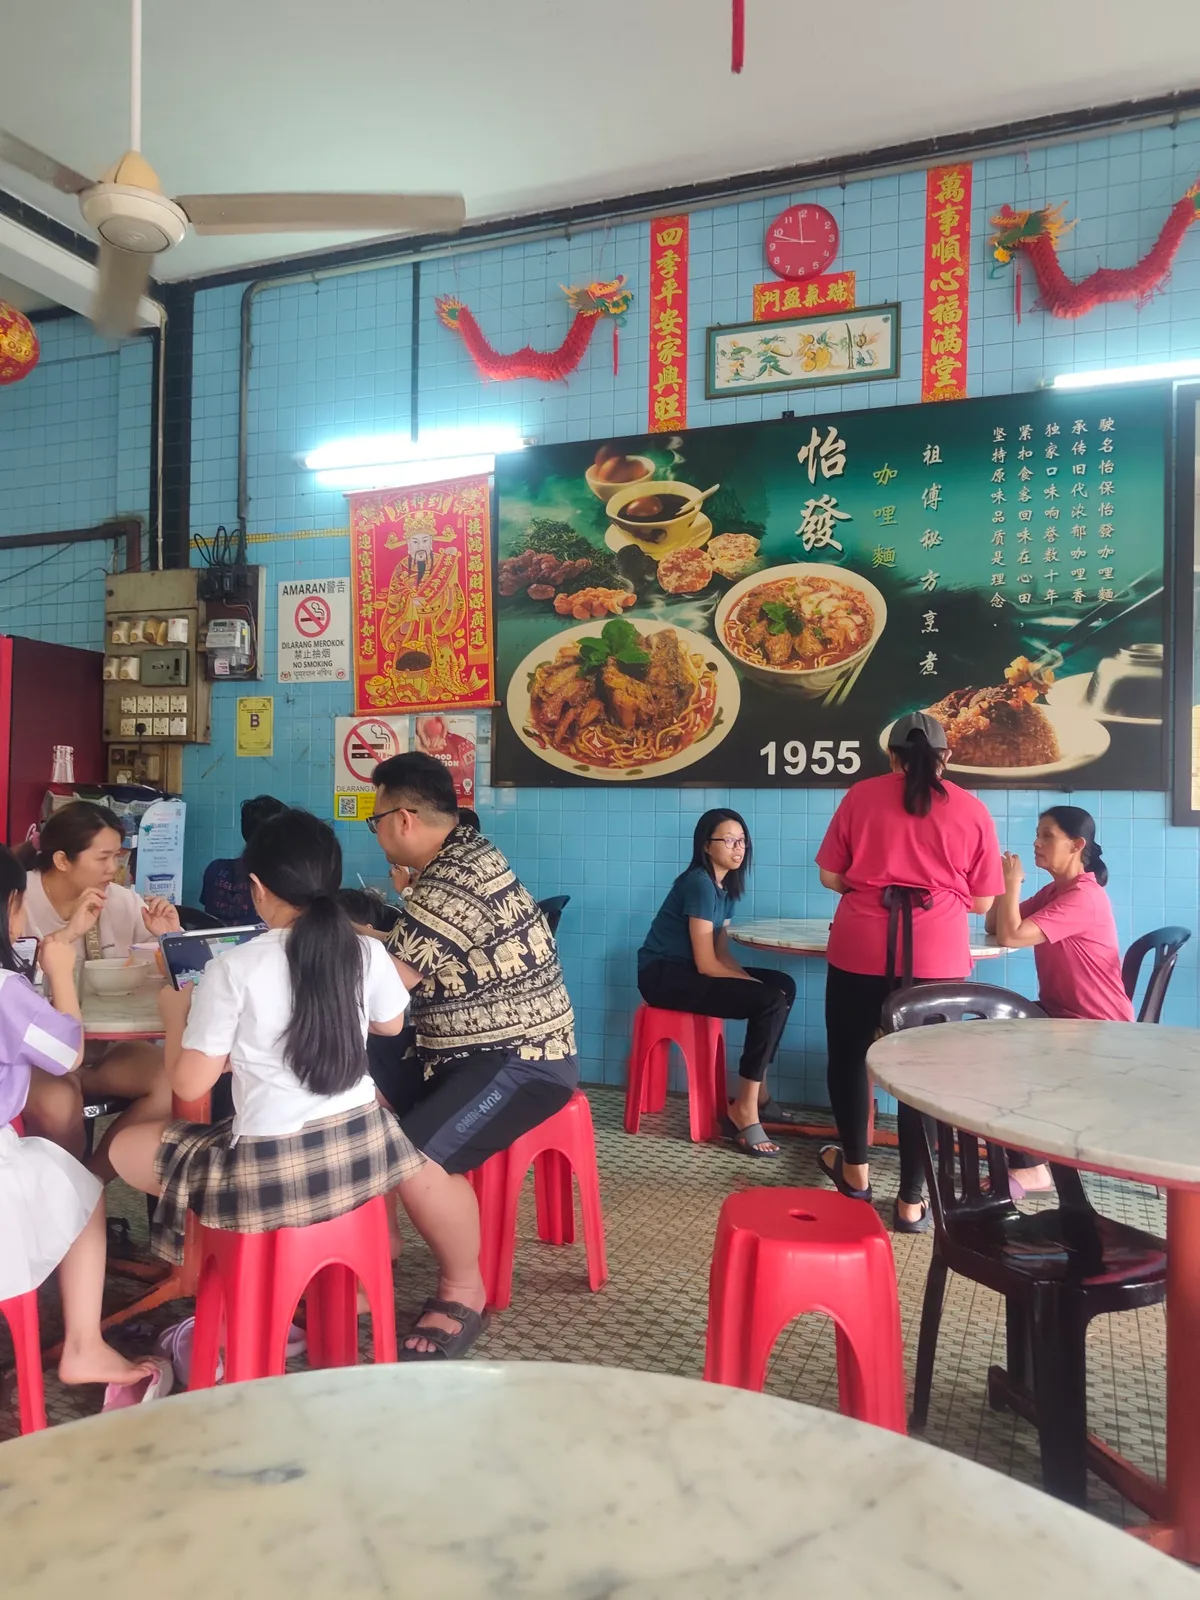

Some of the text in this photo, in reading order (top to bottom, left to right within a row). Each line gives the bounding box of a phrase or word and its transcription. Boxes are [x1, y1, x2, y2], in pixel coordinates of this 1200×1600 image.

[824, 221, 831, 229] 2
[828, 234, 835, 242] 3
[653, 228, 684, 421] 四季平安家興旺
[795, 426, 852, 551] 怡發
[872, 463, 898, 569] 咖哩麵
[282, 639, 345, 649] DILARANG MEROKOK
[303, 660, 333, 668] SMOKING
[250, 713, 260, 728] B
[760, 740, 861, 775] 1955
